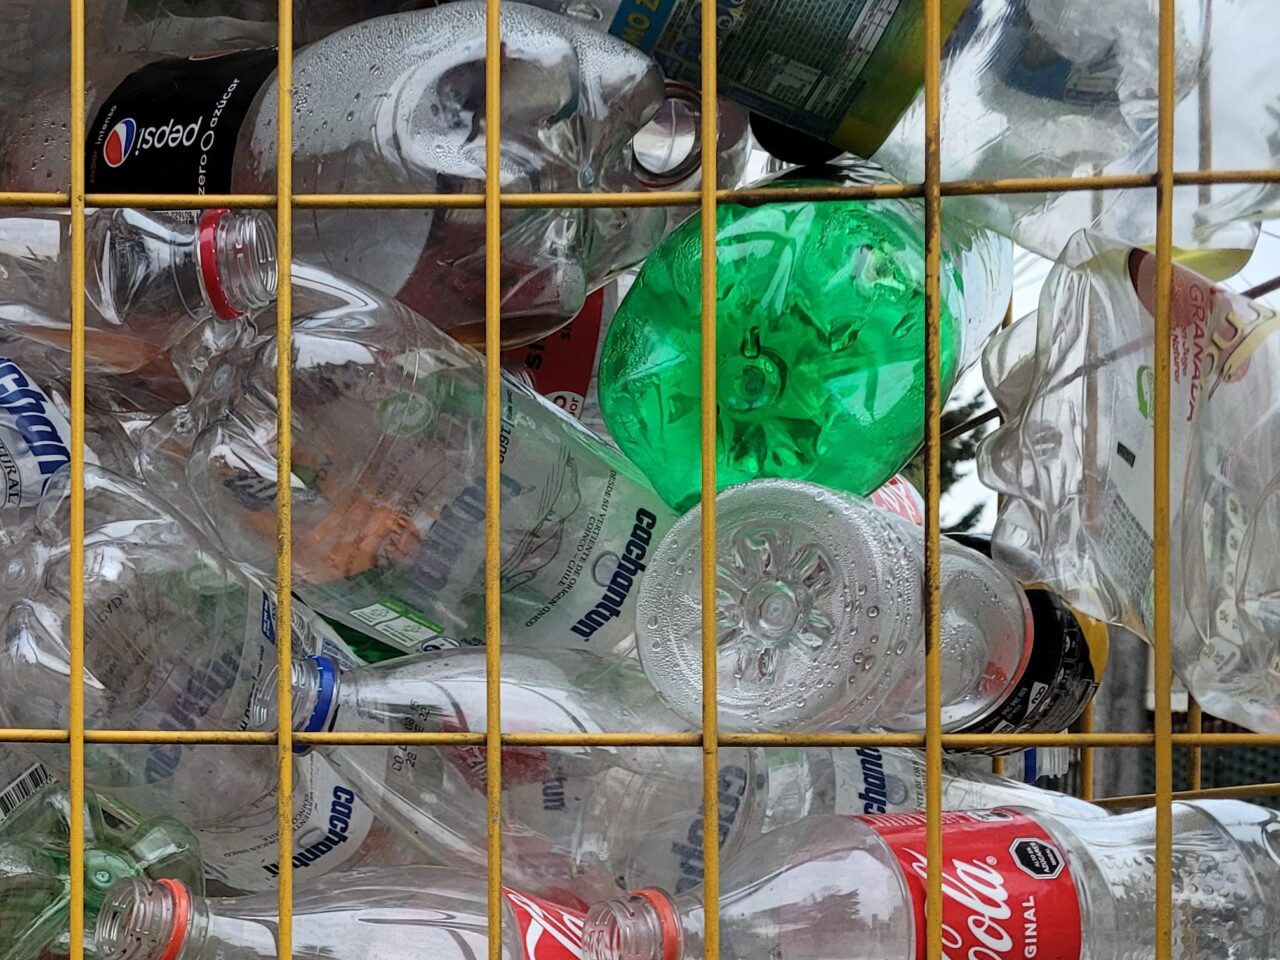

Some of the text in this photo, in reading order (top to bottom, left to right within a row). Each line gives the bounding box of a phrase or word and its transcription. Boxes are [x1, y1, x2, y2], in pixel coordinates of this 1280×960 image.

[95, 104, 118, 146] intenso
[134, 115, 203, 156] pepsi
[197, 77, 241, 196] zero azúcar
[569, 506, 658, 641] cachantun
